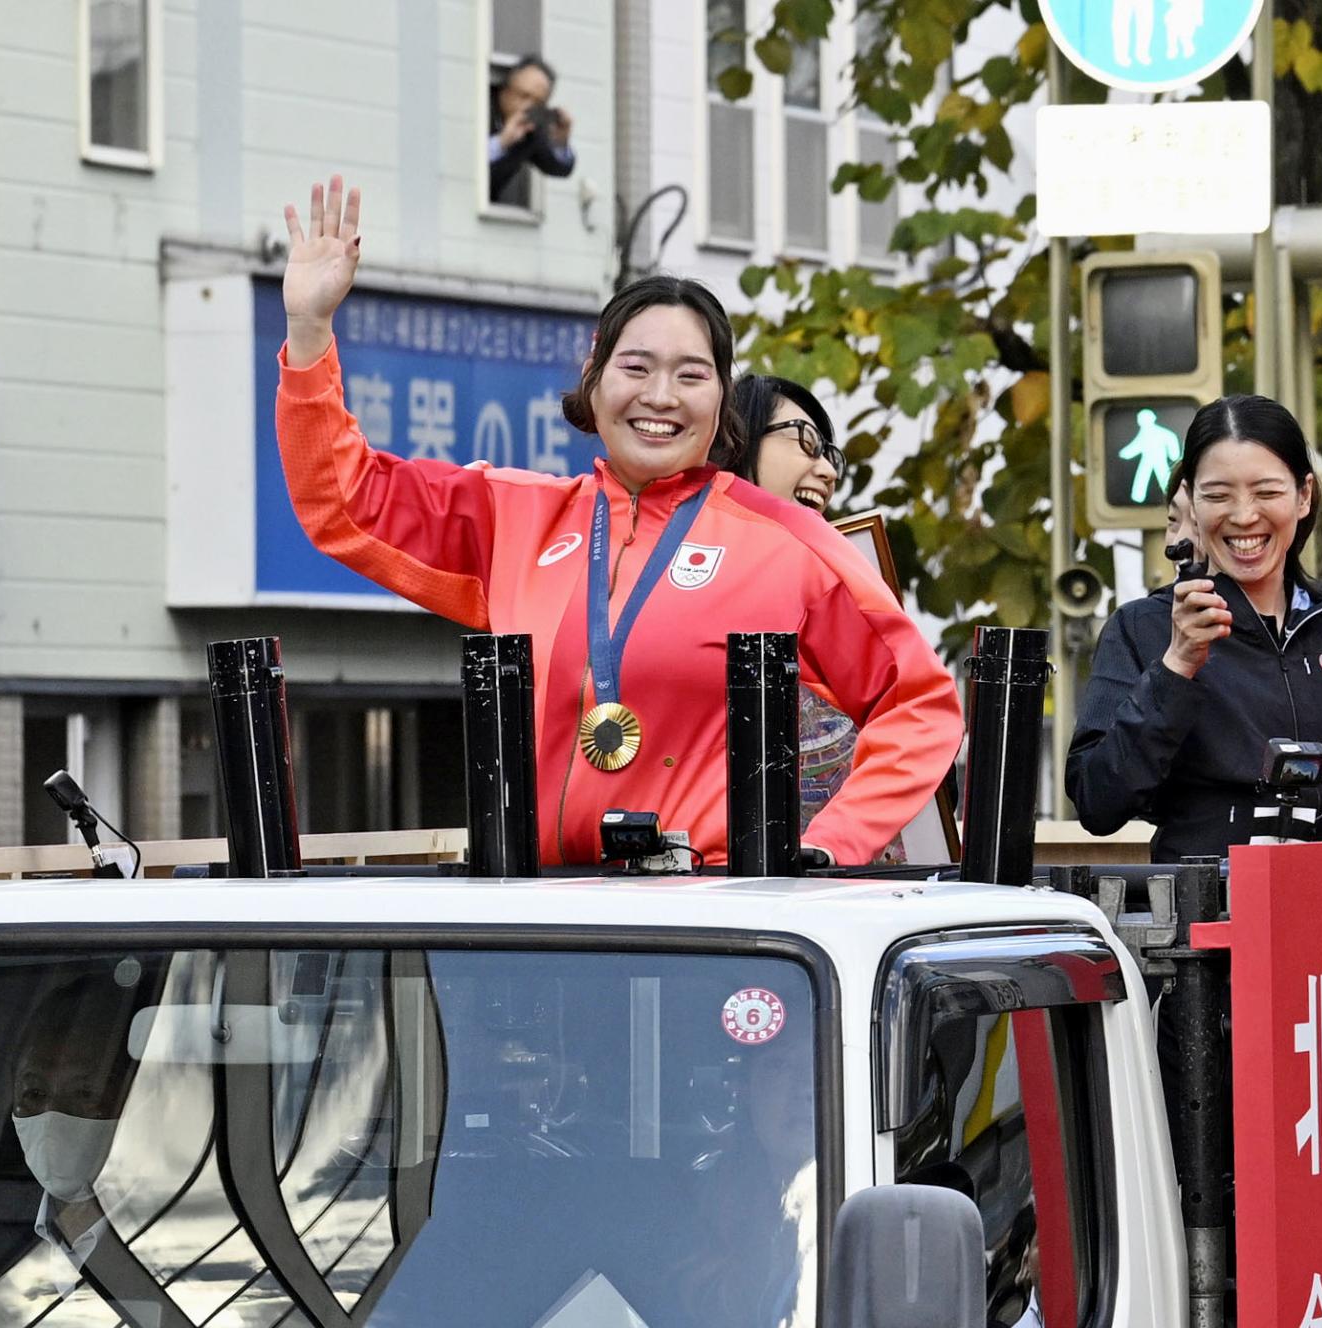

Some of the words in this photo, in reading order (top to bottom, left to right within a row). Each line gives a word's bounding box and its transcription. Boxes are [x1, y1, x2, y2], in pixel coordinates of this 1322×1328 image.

[595, 504, 604, 530] 2024
[593, 532, 602, 560] PARIS
[747, 1008, 760, 1026] 6
